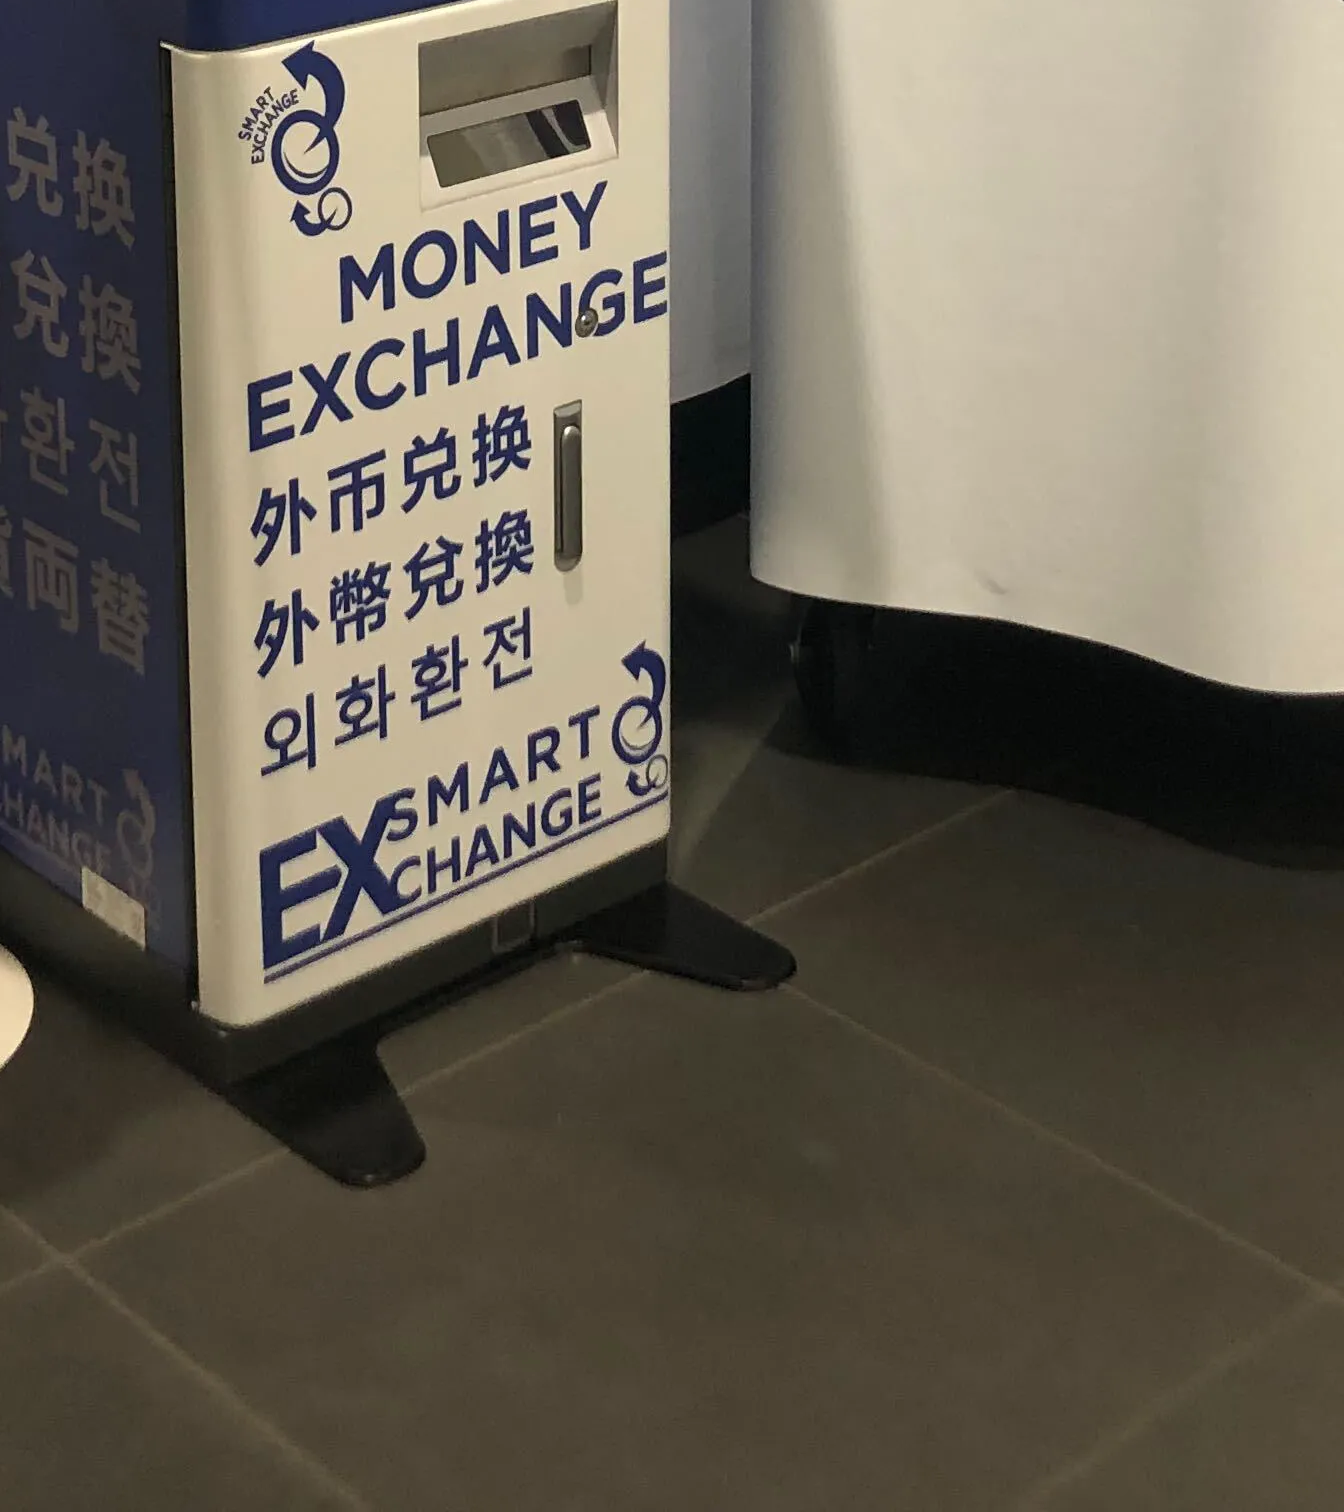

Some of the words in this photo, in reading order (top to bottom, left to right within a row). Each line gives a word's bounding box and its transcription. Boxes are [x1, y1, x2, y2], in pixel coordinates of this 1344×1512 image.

[237, 86, 276, 142] SMART
[250, 88, 300, 164] EXCHANGE
[339, 179, 608, 324] MONEY
[247, 250, 668, 453] EXCHANGE
[250, 404, 532, 567] 外币兑换
[260, 605, 534, 778] 외화환전
[386, 704, 601, 842] SMART
[390, 772, 602, 903] CHANGE
[259, 795, 406, 971] EX
